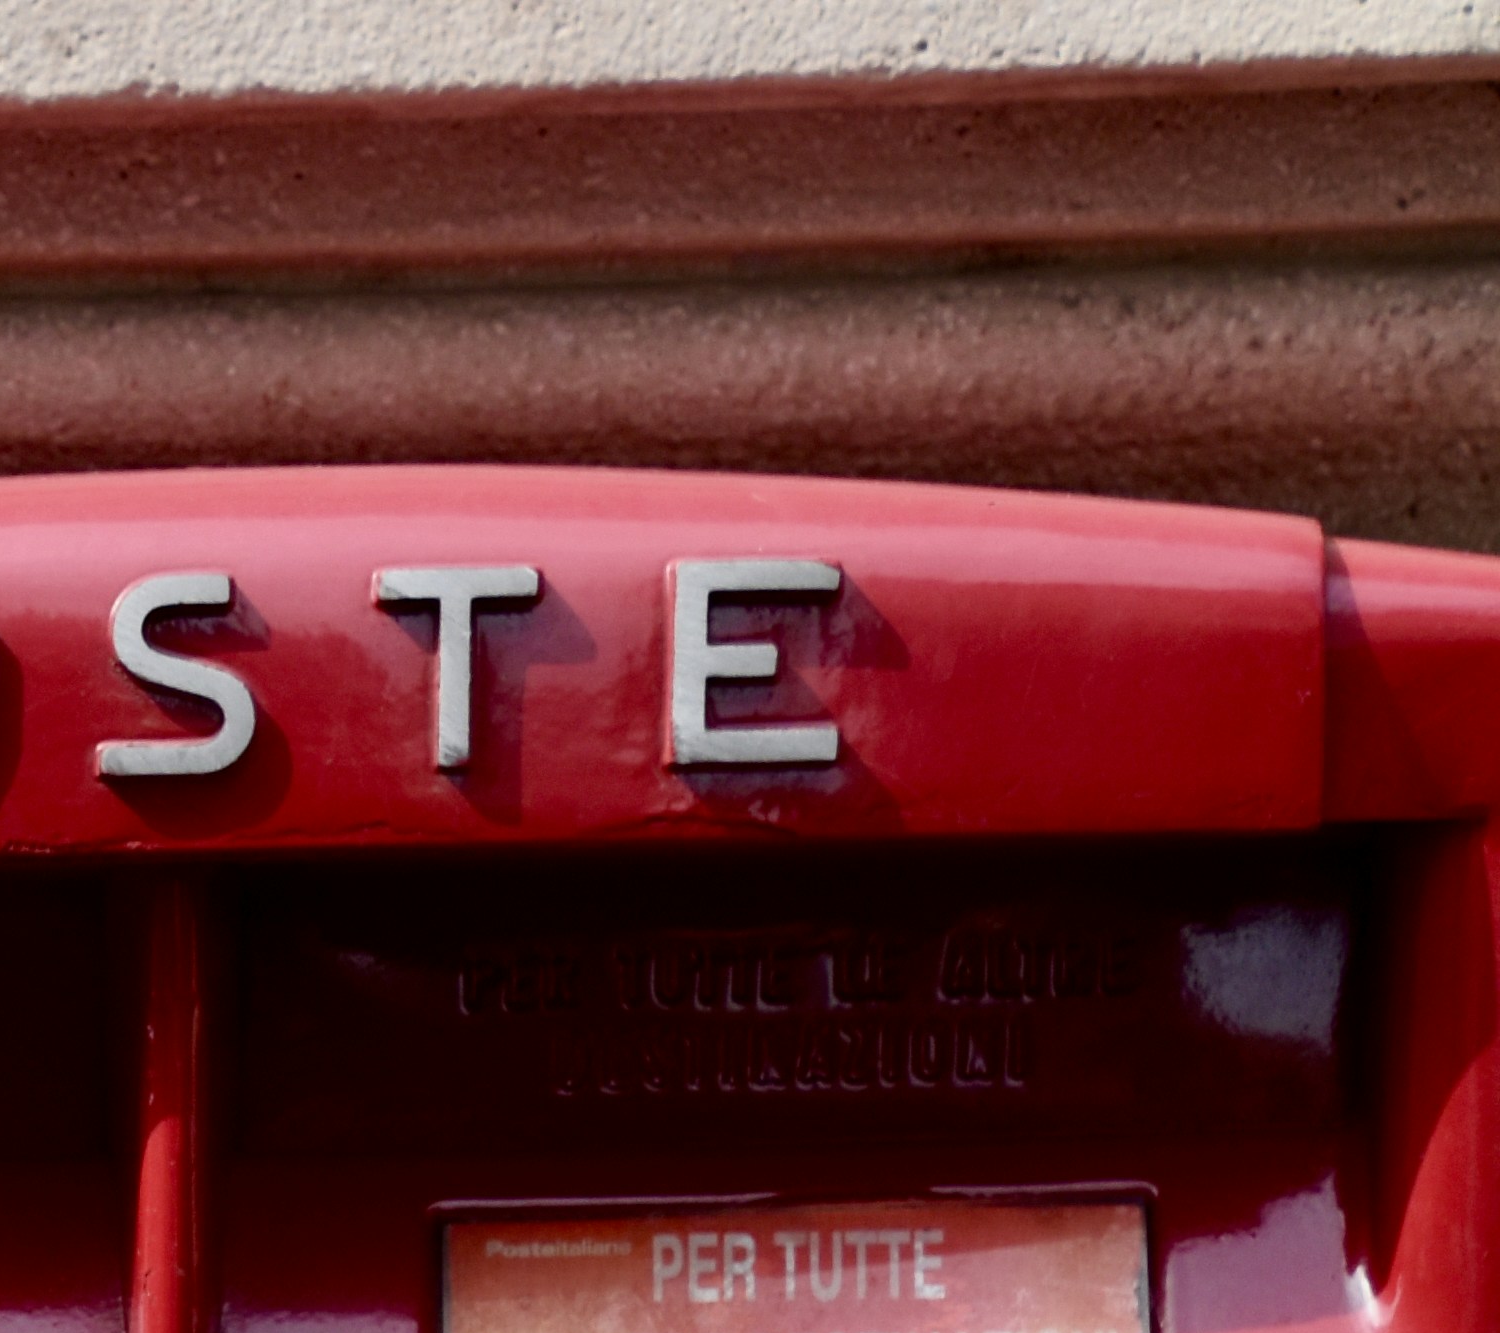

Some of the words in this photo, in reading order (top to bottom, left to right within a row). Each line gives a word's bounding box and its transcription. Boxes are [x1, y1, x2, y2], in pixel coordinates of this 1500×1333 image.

[484, 1238, 633, 1260] Posteitaliane
[651, 1231, 757, 1305] PER
[773, 1228, 947, 1303] TUTTE
